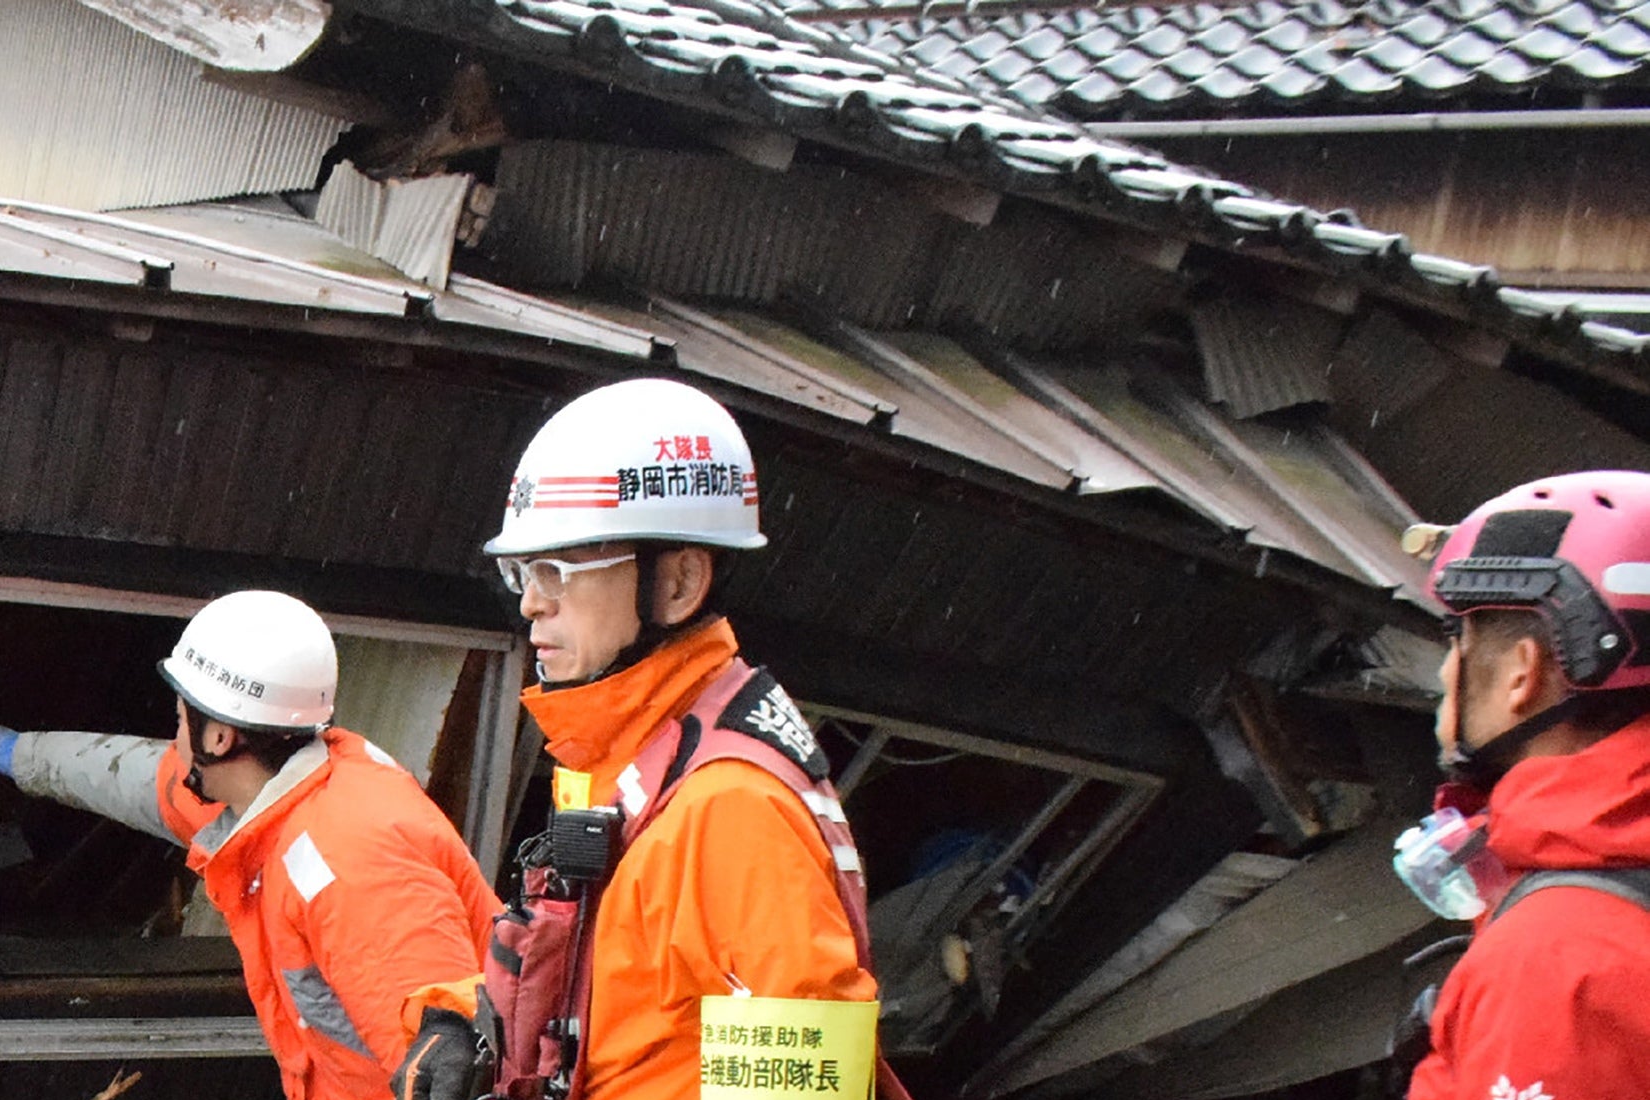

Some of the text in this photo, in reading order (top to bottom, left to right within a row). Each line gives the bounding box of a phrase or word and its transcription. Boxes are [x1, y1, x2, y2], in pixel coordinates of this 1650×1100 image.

[653, 435, 714, 462] 大隊長
[617, 463, 744, 501] 静岡市消防局
[700, 1023, 824, 1049] 急消防援助隊
